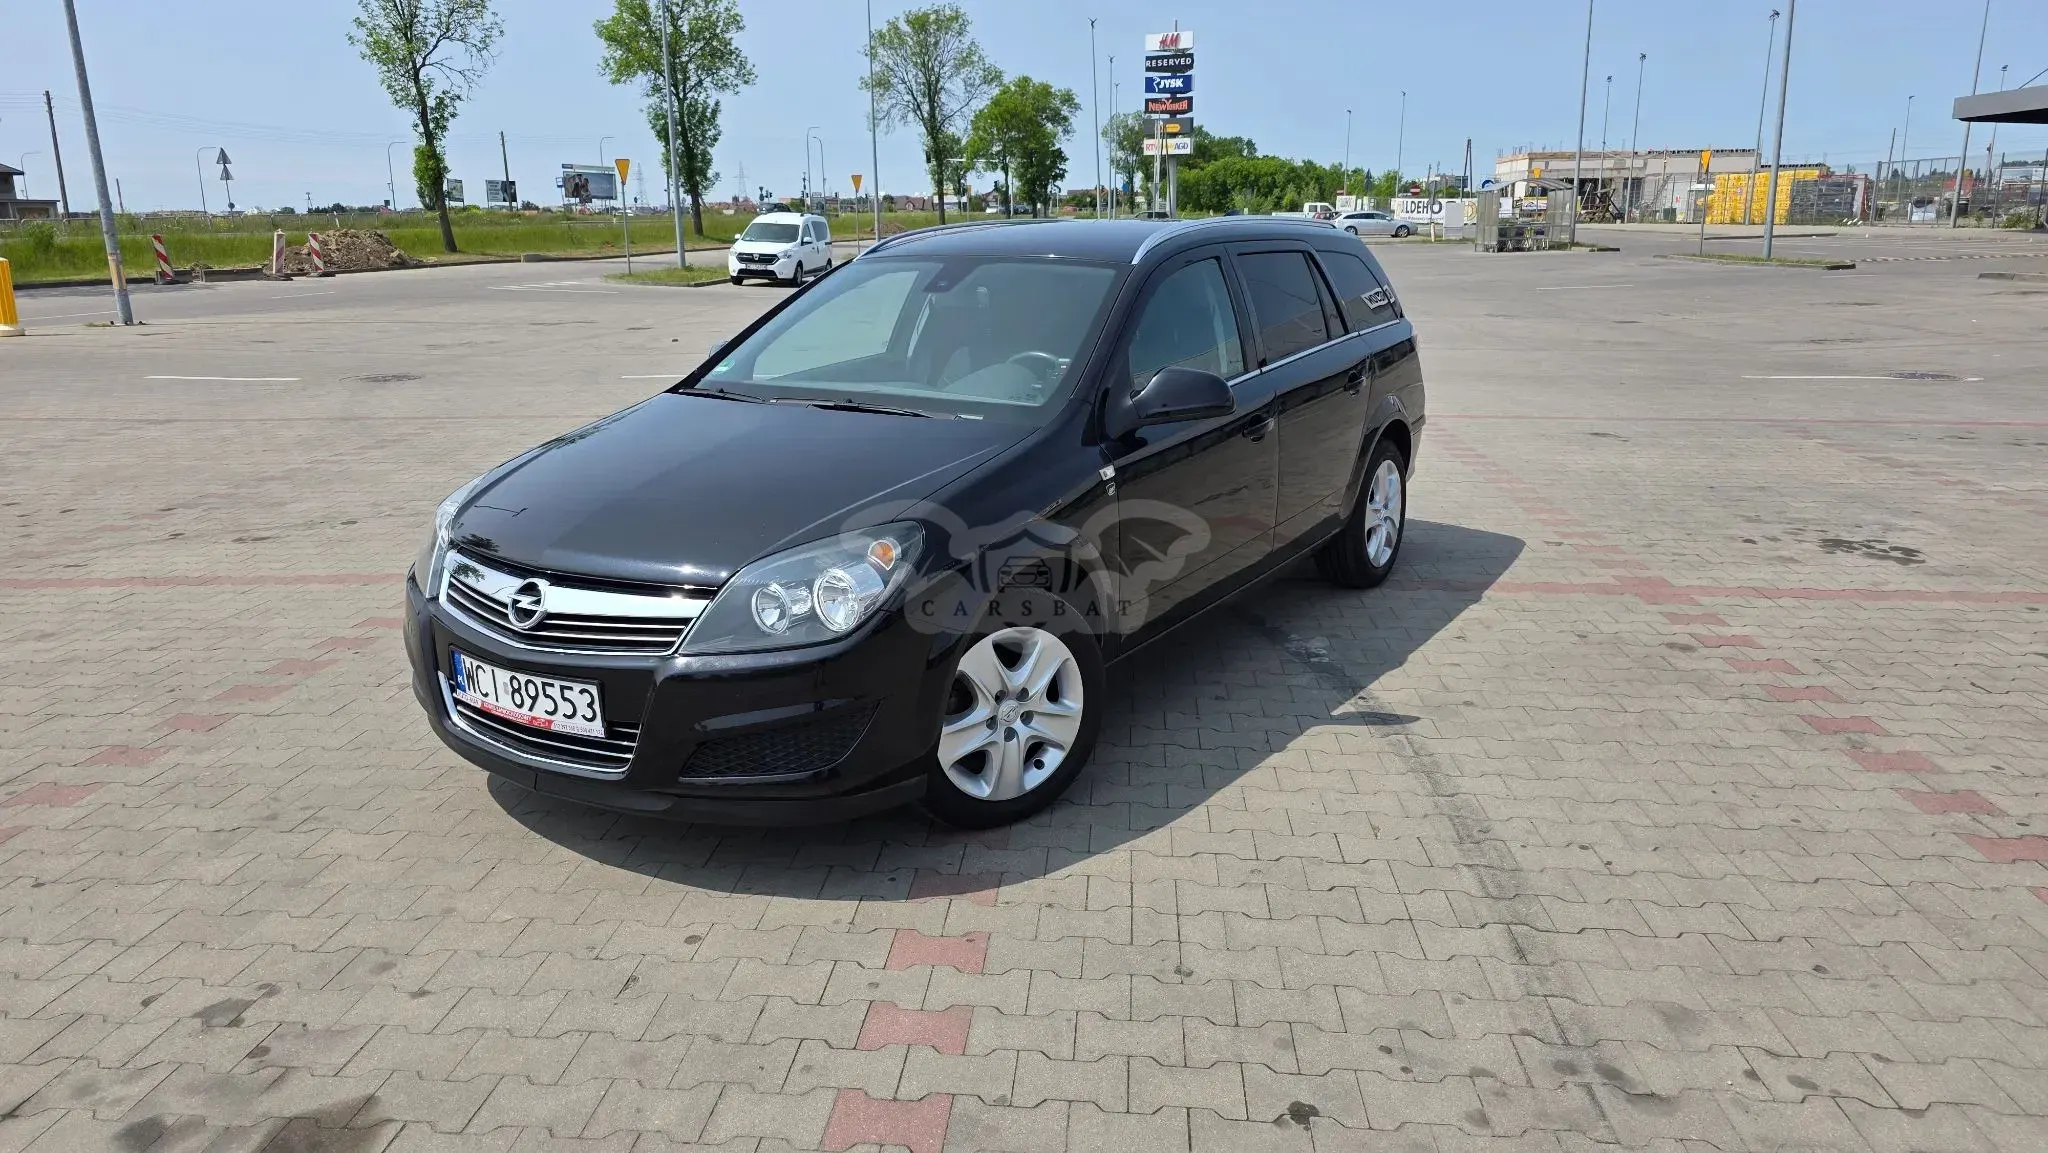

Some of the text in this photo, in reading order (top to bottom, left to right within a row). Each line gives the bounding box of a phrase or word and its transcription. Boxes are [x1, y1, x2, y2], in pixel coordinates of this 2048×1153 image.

[1146, 57, 1192, 68] RESERVED
[1159, 78, 1183, 89] JYSK
[1174, 142, 1188, 150] AGD
[463, 657, 500, 703] WCI
[509, 674, 597, 723] 89553
